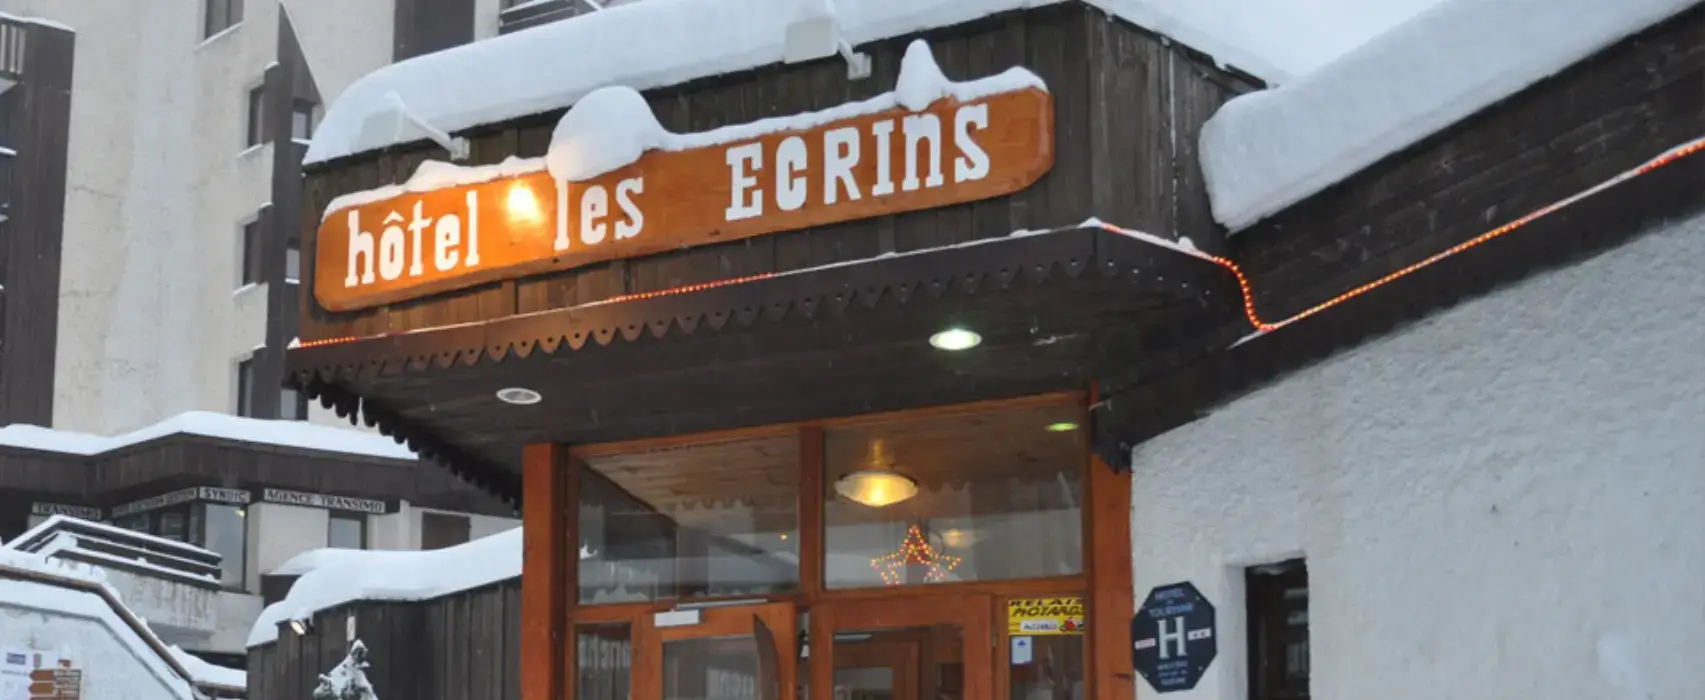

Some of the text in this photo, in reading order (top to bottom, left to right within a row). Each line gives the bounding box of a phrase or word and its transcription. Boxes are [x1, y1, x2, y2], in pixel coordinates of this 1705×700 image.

[345, 191, 480, 286] hôtel
[553, 176, 645, 251] les
[204, 488, 248, 502] SYNDIC
[266, 488, 384, 512] AGENCE TRANSIMO
[1157, 616, 1187, 659] H
